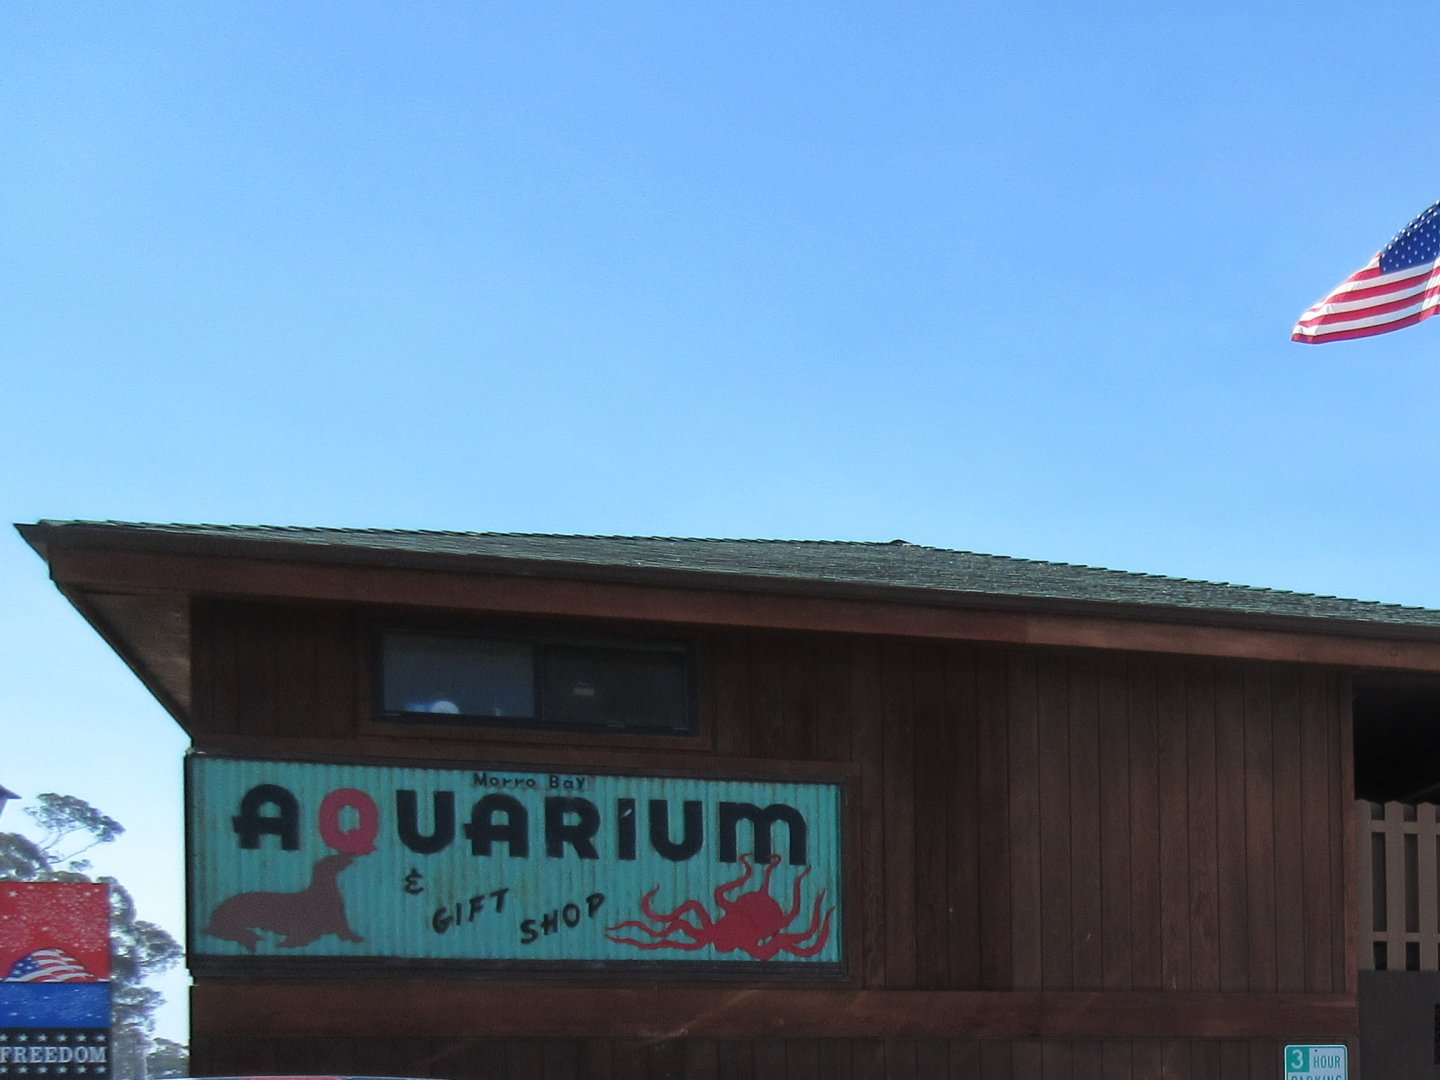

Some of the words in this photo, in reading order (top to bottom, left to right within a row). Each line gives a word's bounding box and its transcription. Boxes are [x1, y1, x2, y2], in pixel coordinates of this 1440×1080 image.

[473, 772, 536, 787] Morro
[548, 775, 585, 789] Bay
[432, 888, 510, 934] GIFT
[519, 892, 606, 945] SHOP
[0, 1046, 108, 1064] FREEDOM
[1291, 1048, 1304, 1069] 3
[1313, 1055, 1341, 1069] HOUR
